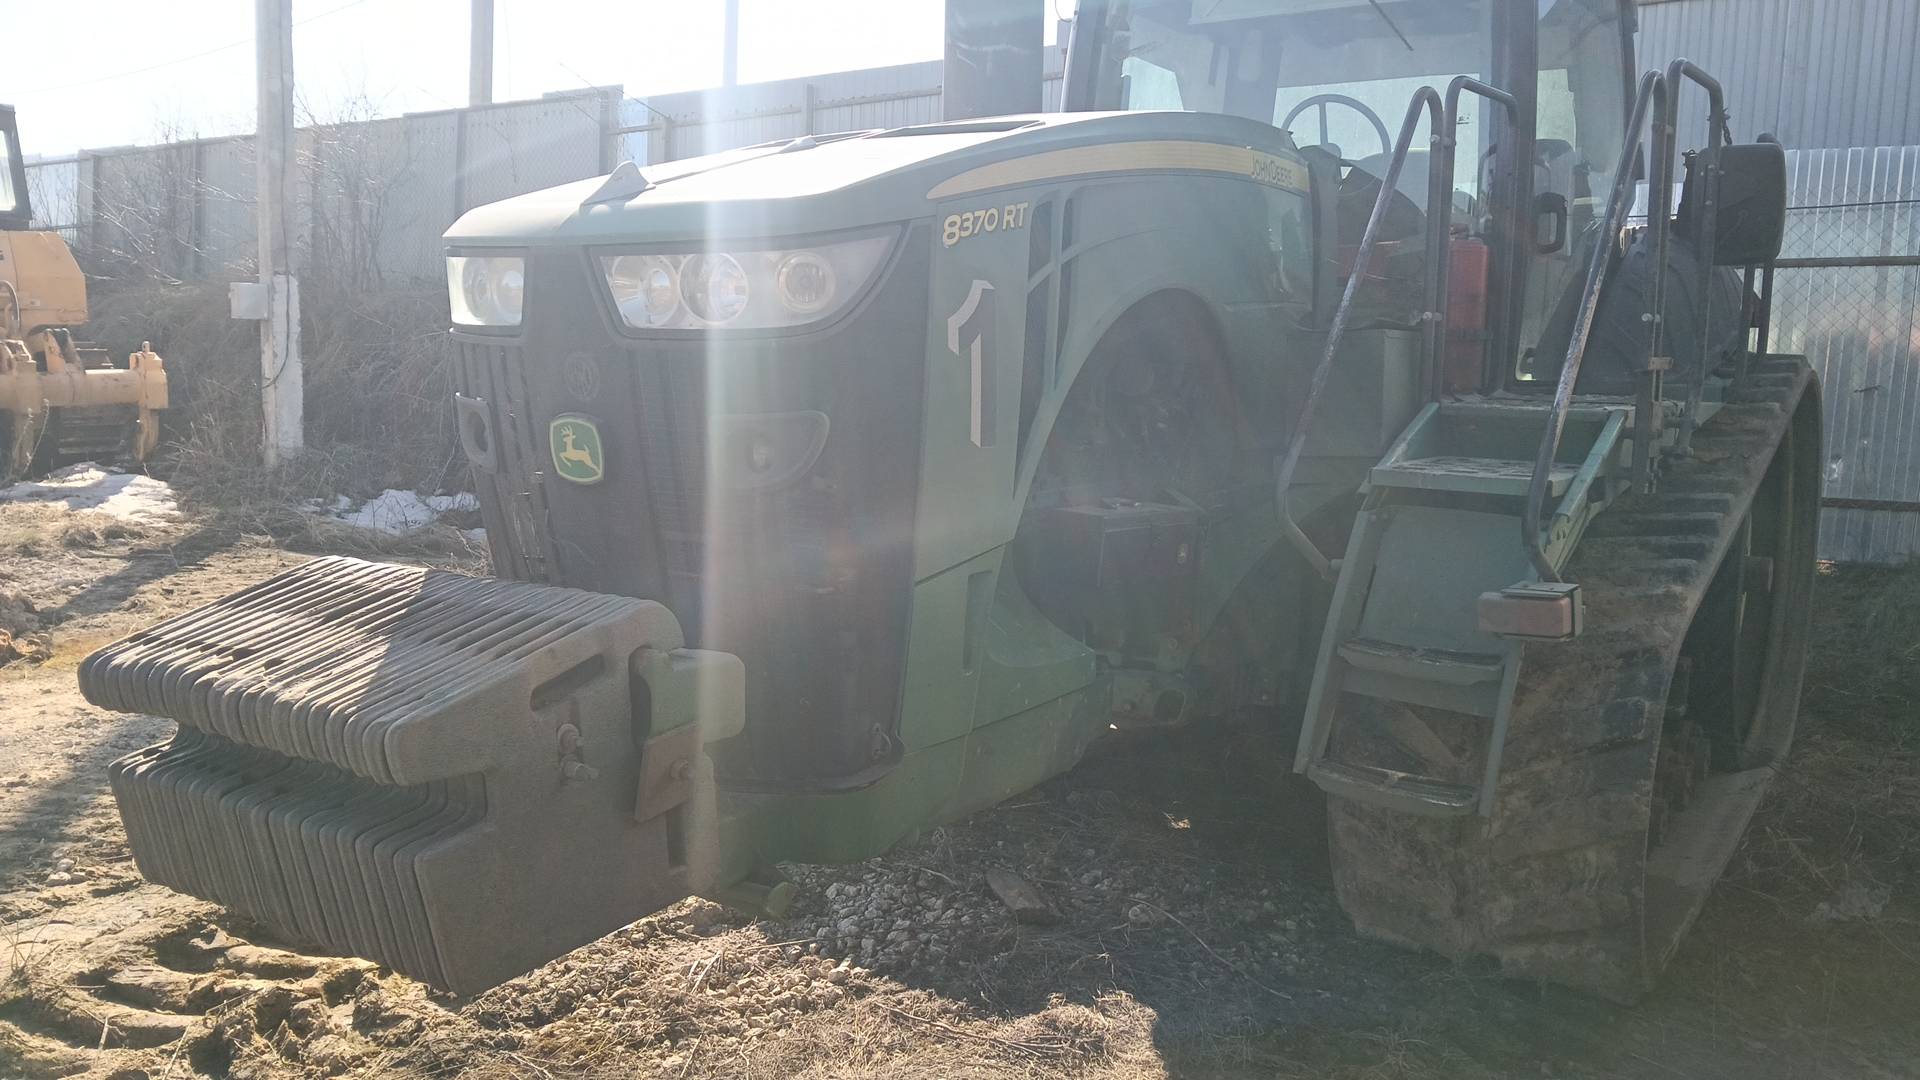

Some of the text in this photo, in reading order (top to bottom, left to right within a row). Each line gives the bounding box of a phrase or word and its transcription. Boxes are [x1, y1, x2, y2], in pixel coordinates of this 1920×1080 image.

[943, 202, 1029, 246] 8370 RT
[948, 280, 996, 447] 1
